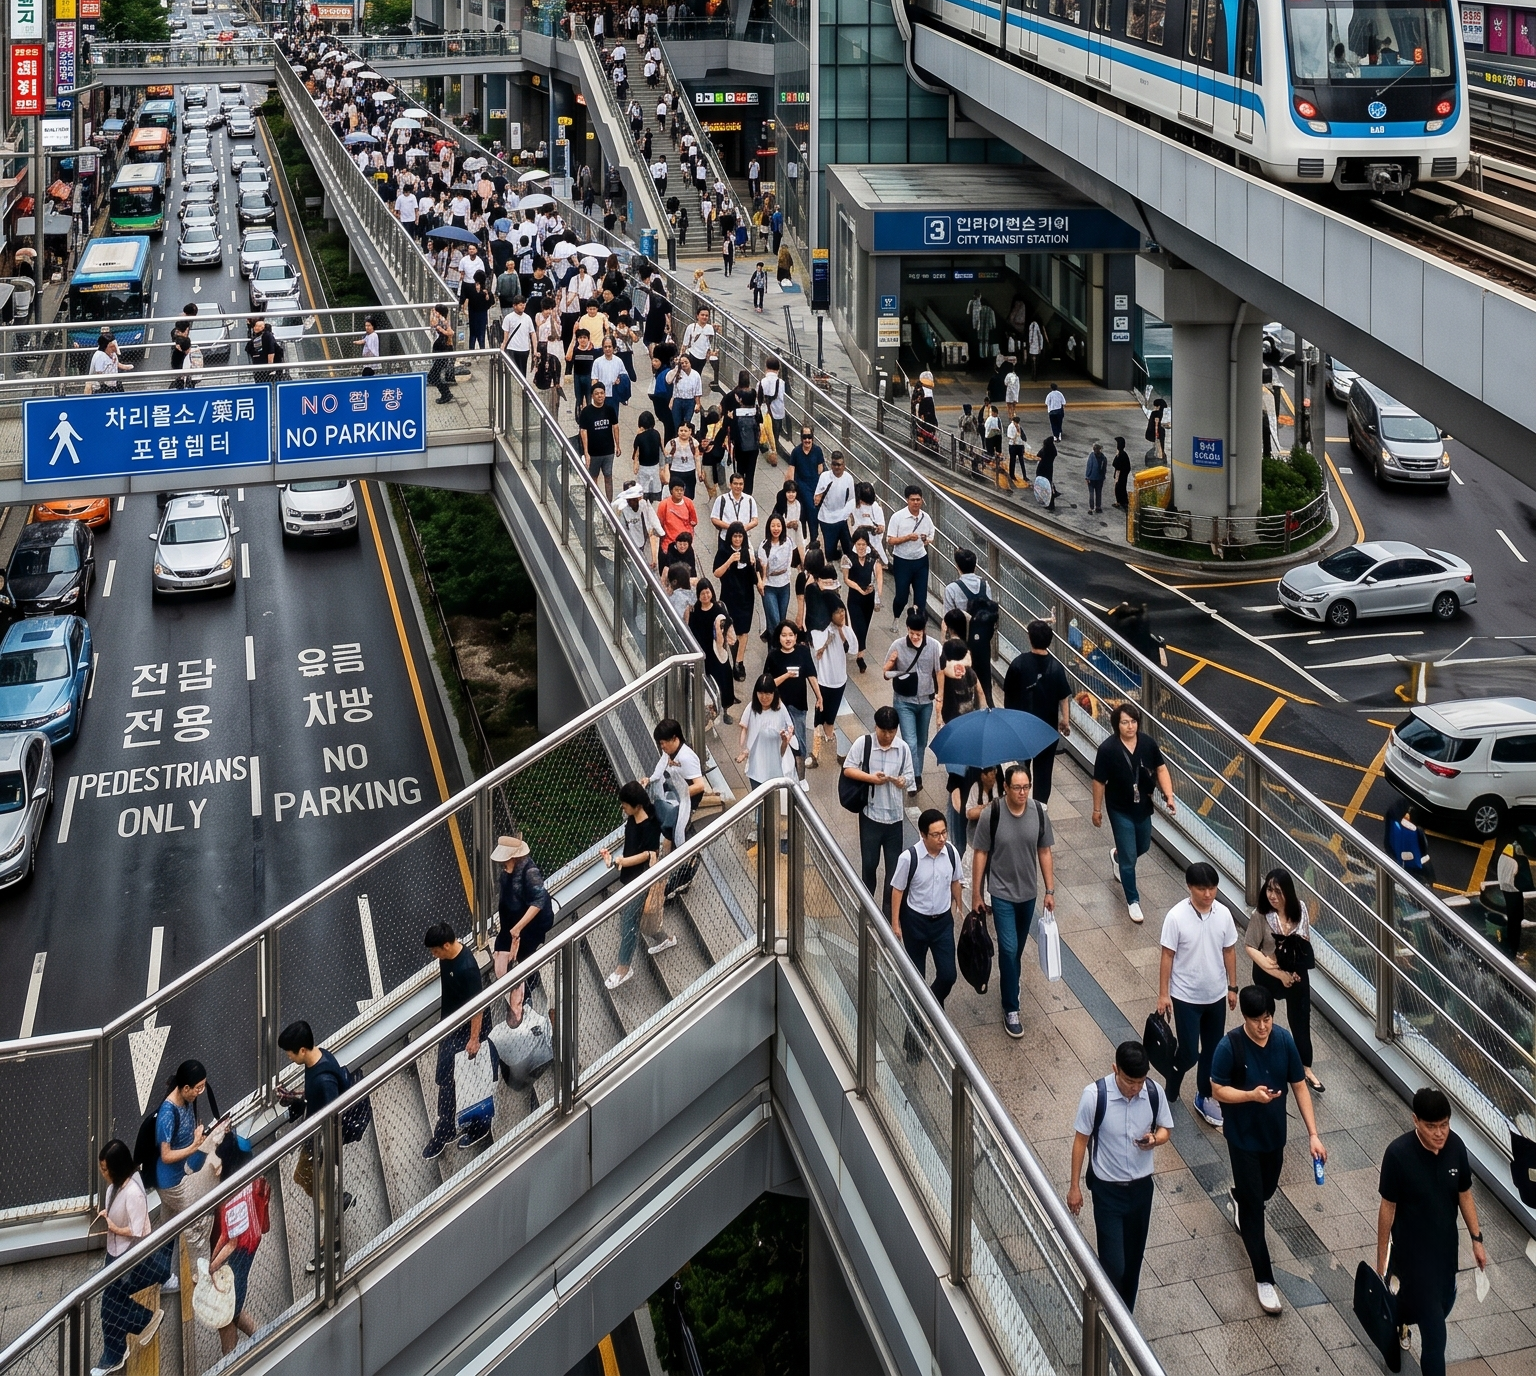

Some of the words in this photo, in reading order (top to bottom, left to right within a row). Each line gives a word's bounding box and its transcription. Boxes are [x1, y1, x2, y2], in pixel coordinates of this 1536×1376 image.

[930, 219, 945, 240] 3
[957, 235, 980, 245] CITY
[982, 235, 1024, 244] TRANSIT
[1027, 234, 1069, 244] STATION
[301, 393, 339, 415] NO
[286, 426, 318, 449] NO
[325, 419, 417, 446] PARKING
[131, 657, 218, 698] 전담
[122, 704, 213, 750] 전용
[322, 743, 369, 774] NO
[79, 755, 248, 800] PEDESTRIANS
[273, 776, 422, 823] PARKING
[117, 798, 208, 839] ONLY
